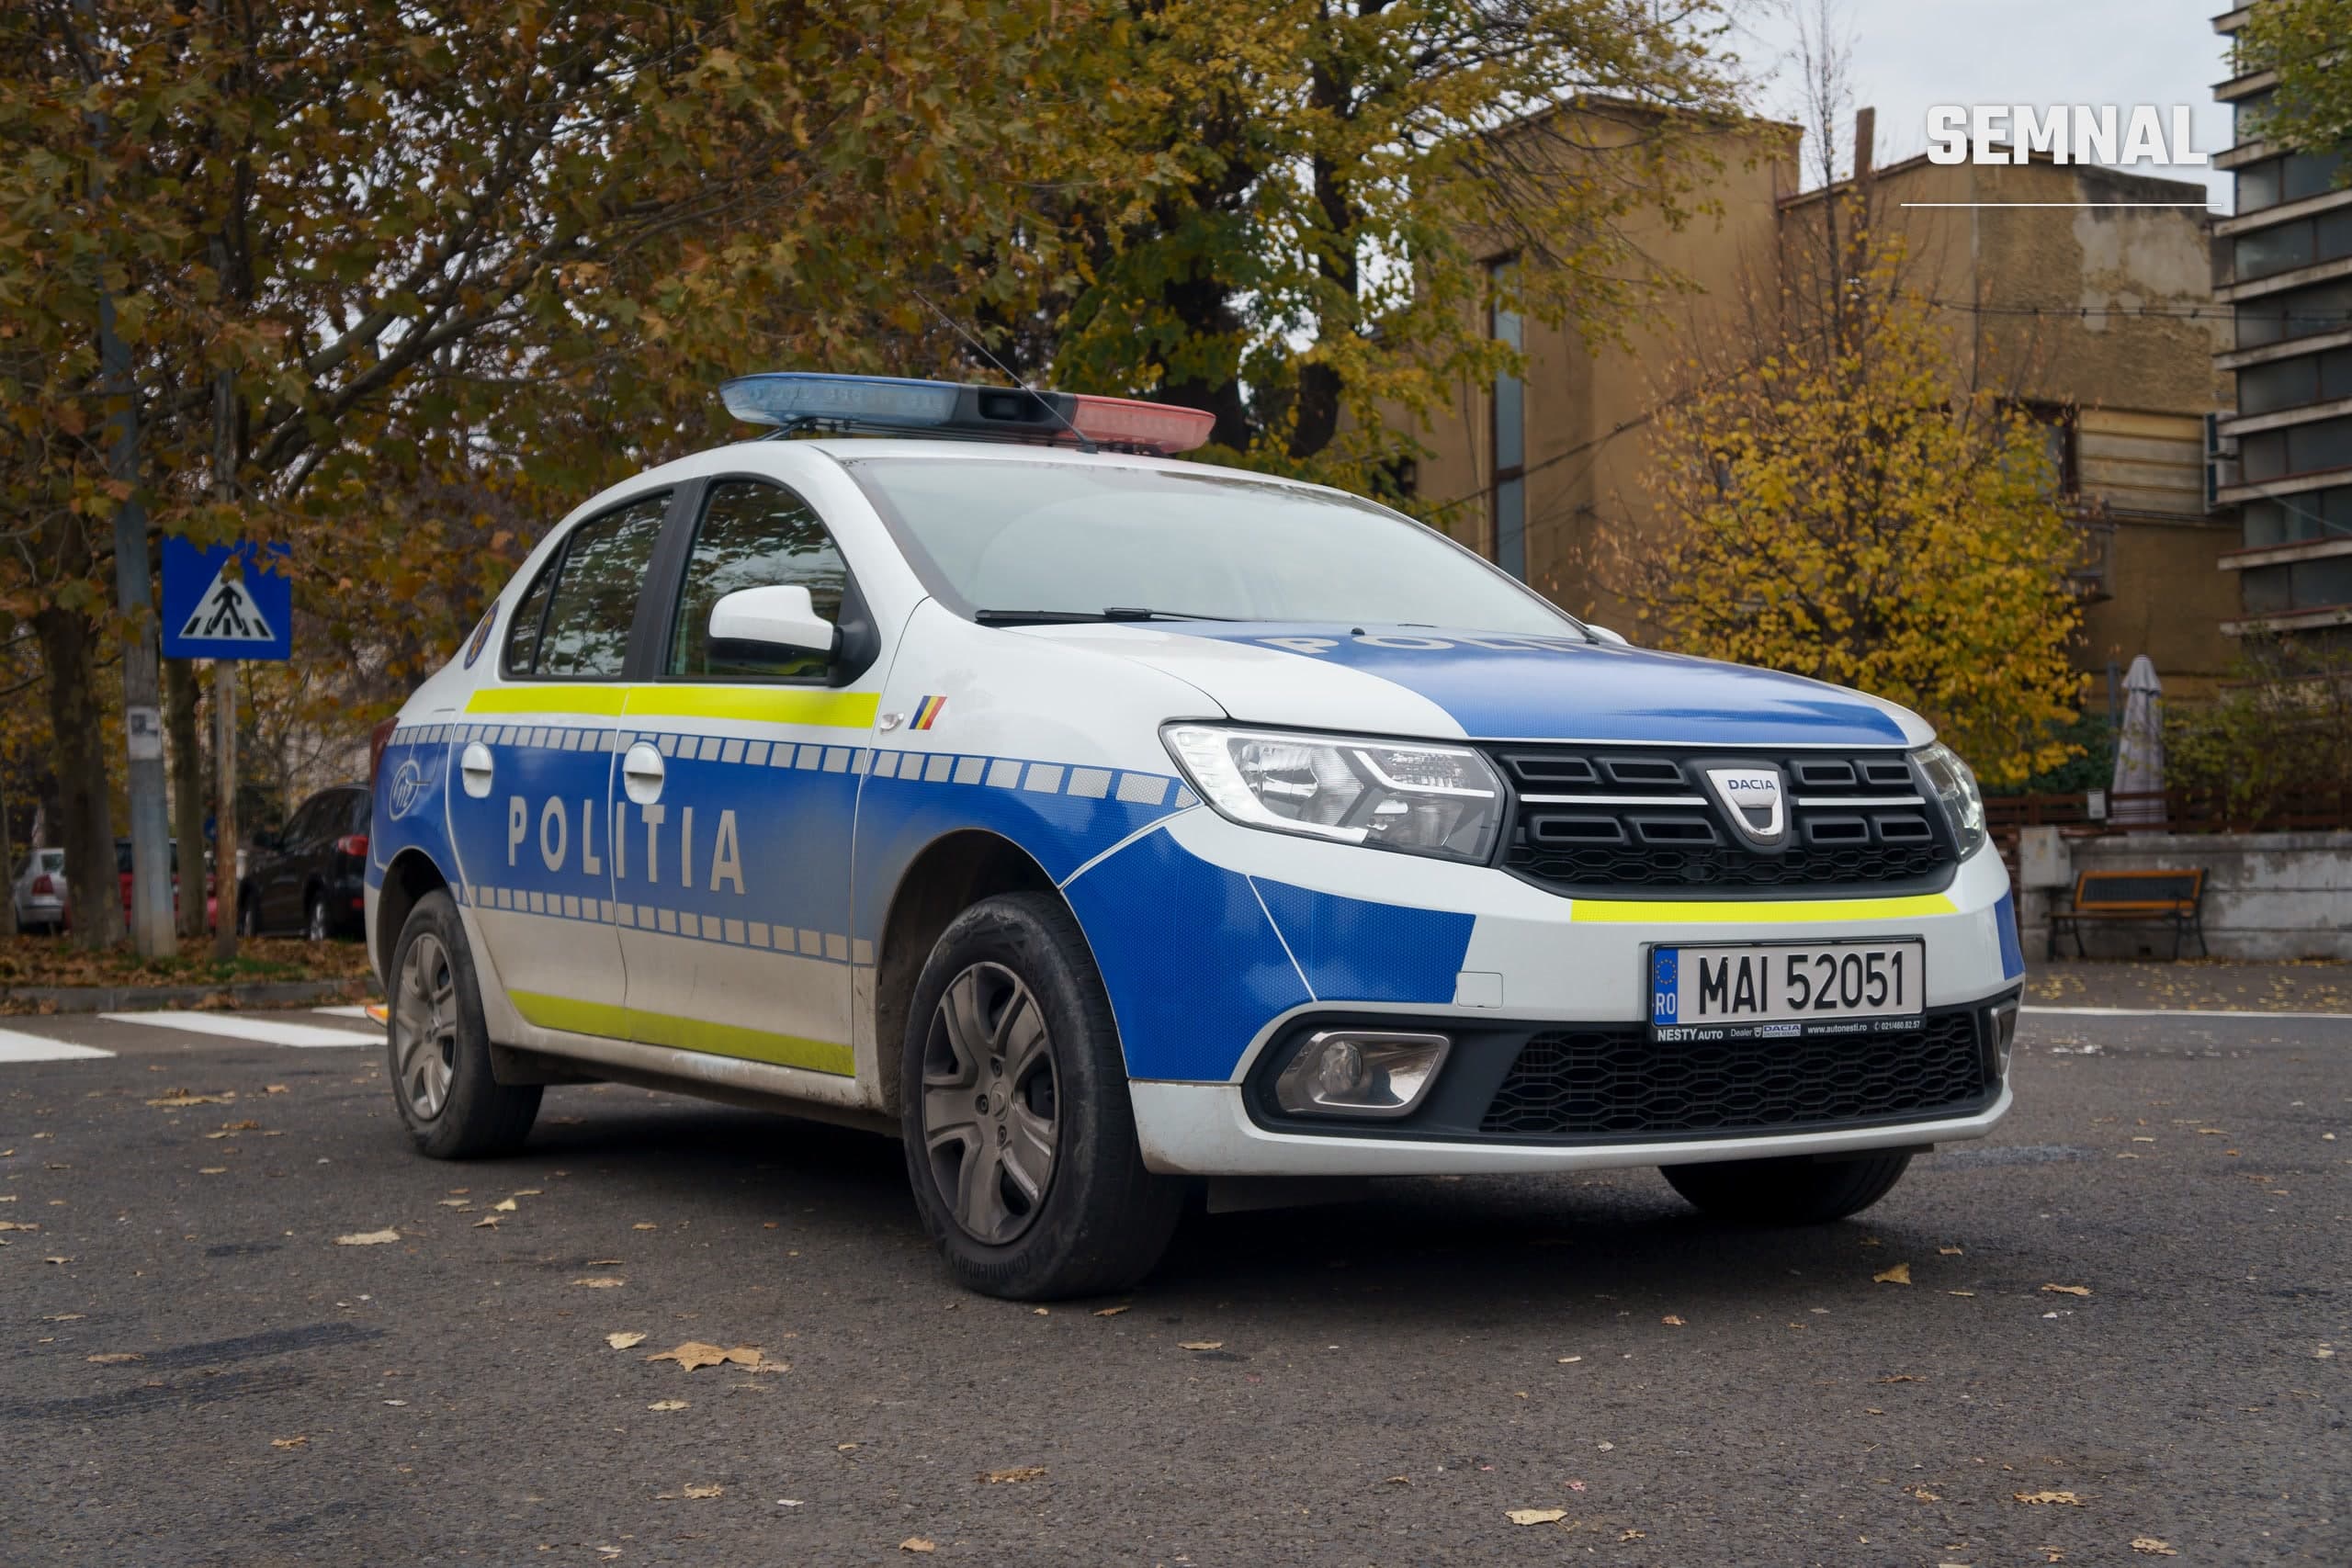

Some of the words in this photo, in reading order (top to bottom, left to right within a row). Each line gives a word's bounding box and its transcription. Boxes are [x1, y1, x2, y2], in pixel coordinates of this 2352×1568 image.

[1727, 779, 1776, 790] DACIA
[508, 795, 746, 896] POLITIA
[1699, 955, 1768, 1014] MAI
[1786, 951, 1903, 1010] 52051
[1656, 992, 1677, 1015] RO
[1657, 1028, 1697, 1042] NESTY
[1698, 1030, 1724, 1040] AUTO
[1731, 1027, 1753, 1037] Dealer
